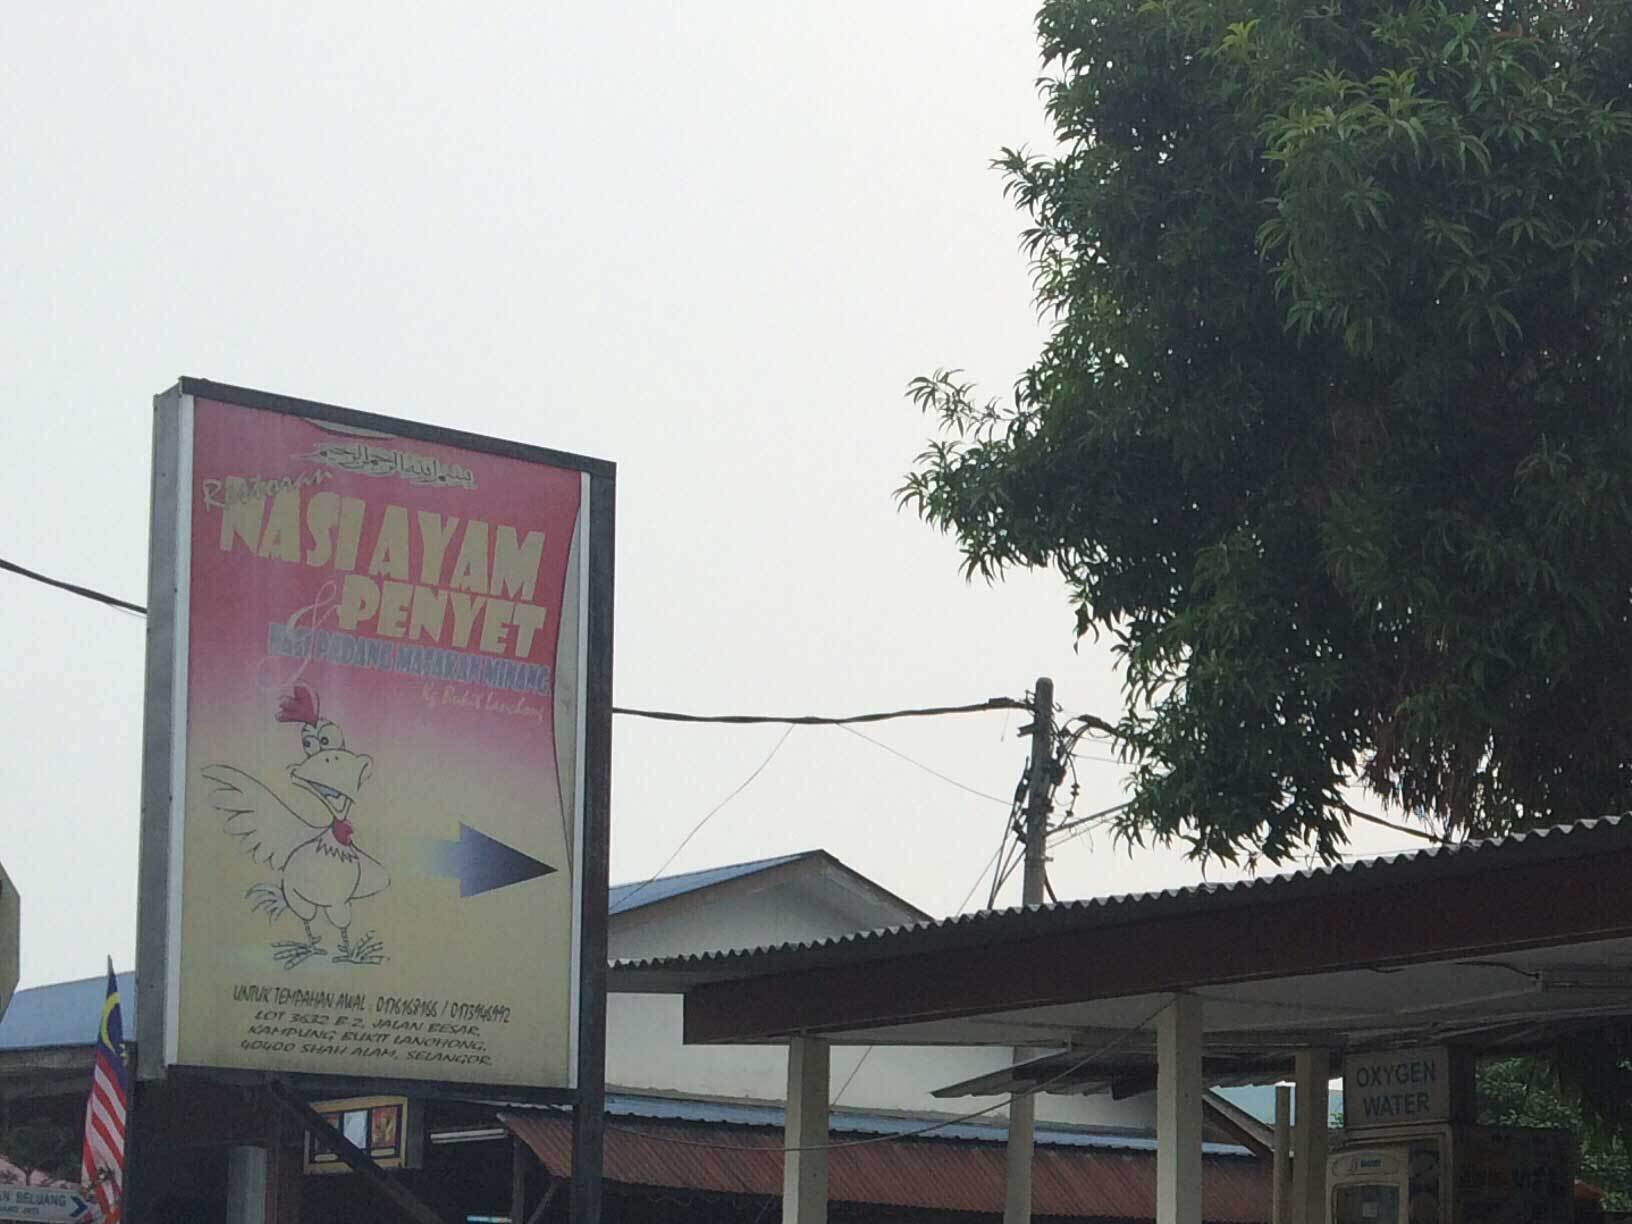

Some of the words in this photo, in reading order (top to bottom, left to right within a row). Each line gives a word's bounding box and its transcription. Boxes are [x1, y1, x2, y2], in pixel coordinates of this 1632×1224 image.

[219, 477, 366, 571] NASI
[369, 504, 546, 601] AYAM
[337, 574, 547, 658] PENYET
[233, 984, 272, 1003] UNTUK
[274, 987, 335, 1008] TEMPAHAN
[254, 1009, 286, 1021] LOT
[372, 1018, 424, 1031] JALAN
[247, 1024, 336, 1041] KAMPUNG
[341, 1031, 391, 1043] BUKIT
[299, 1043, 349, 1056] SHAH
[1356, 1060, 1436, 1088] OXYGEN
[1363, 1092, 1431, 1117] WATER
